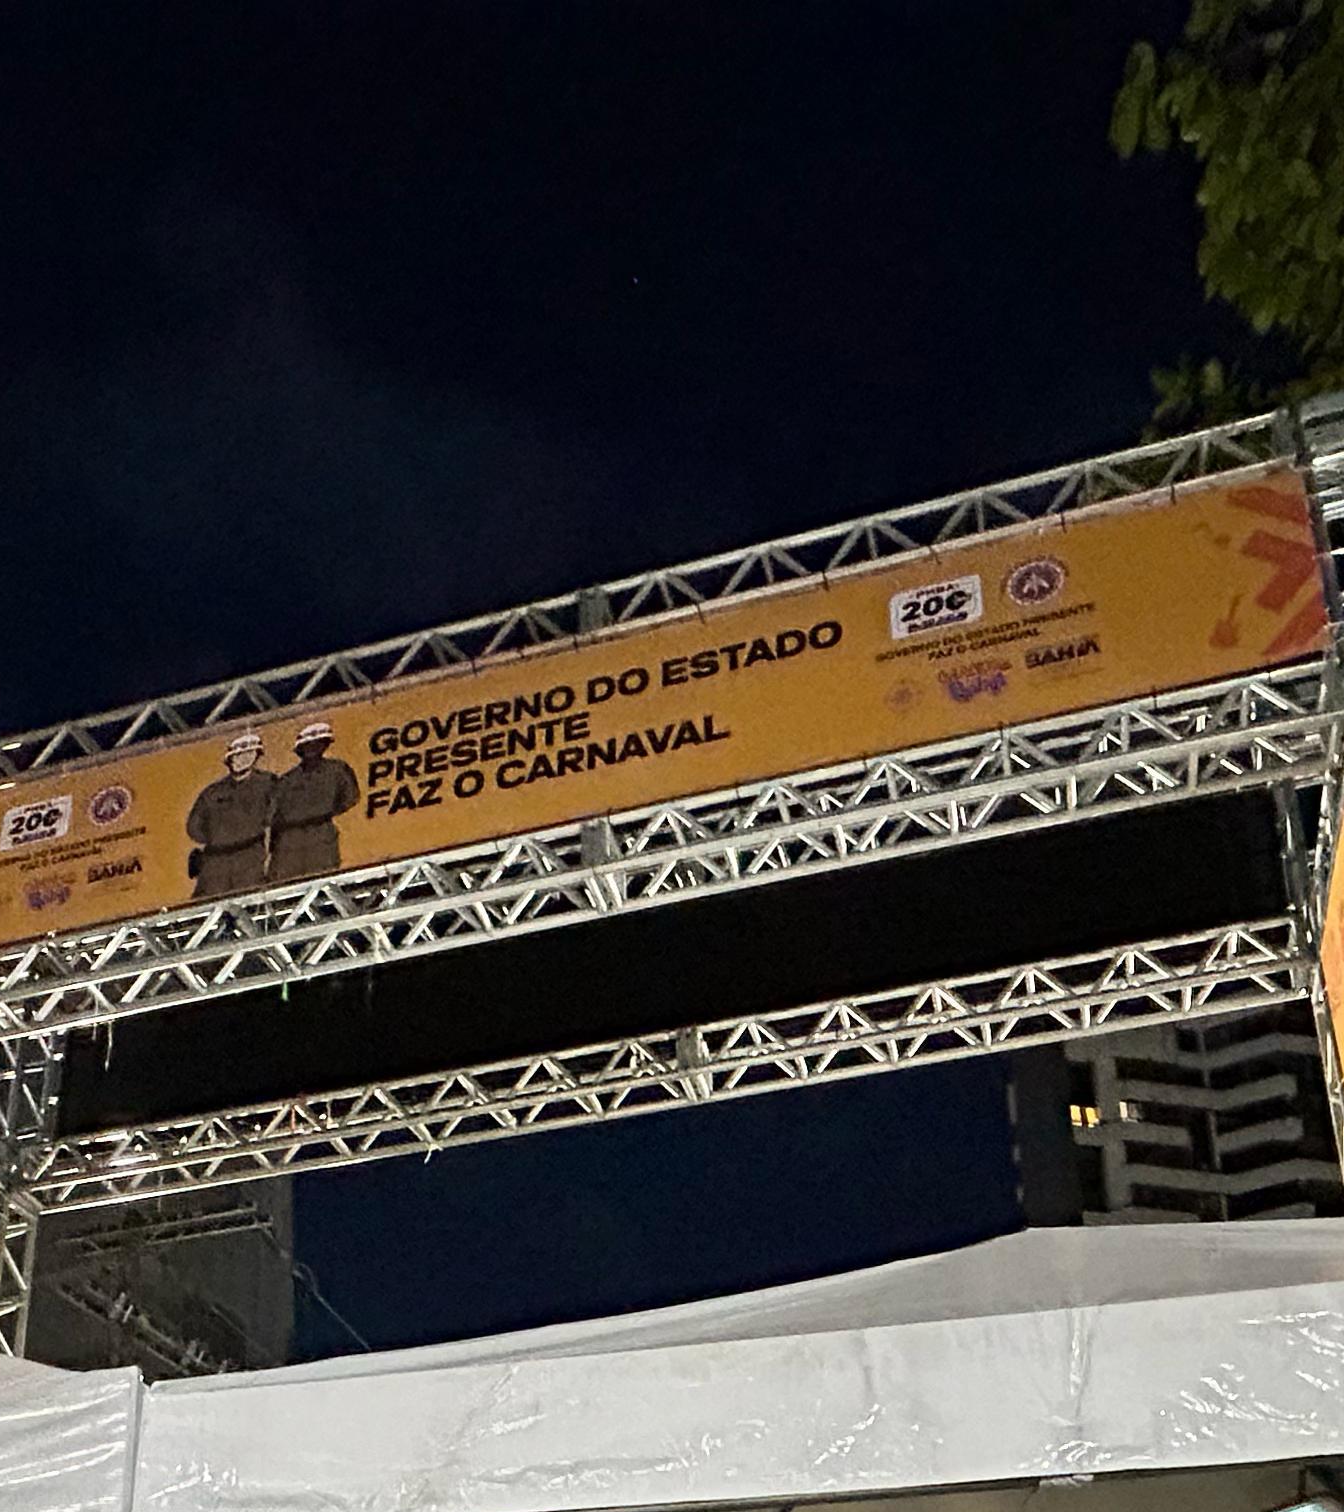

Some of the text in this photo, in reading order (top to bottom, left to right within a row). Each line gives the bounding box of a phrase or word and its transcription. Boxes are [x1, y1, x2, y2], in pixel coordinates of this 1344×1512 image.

[368, 620, 843, 756] GOVERNO DO ESTADO
[366, 715, 731, 819] FAZ O CARNAVAL
[367, 712, 590, 788] PRESENTE
